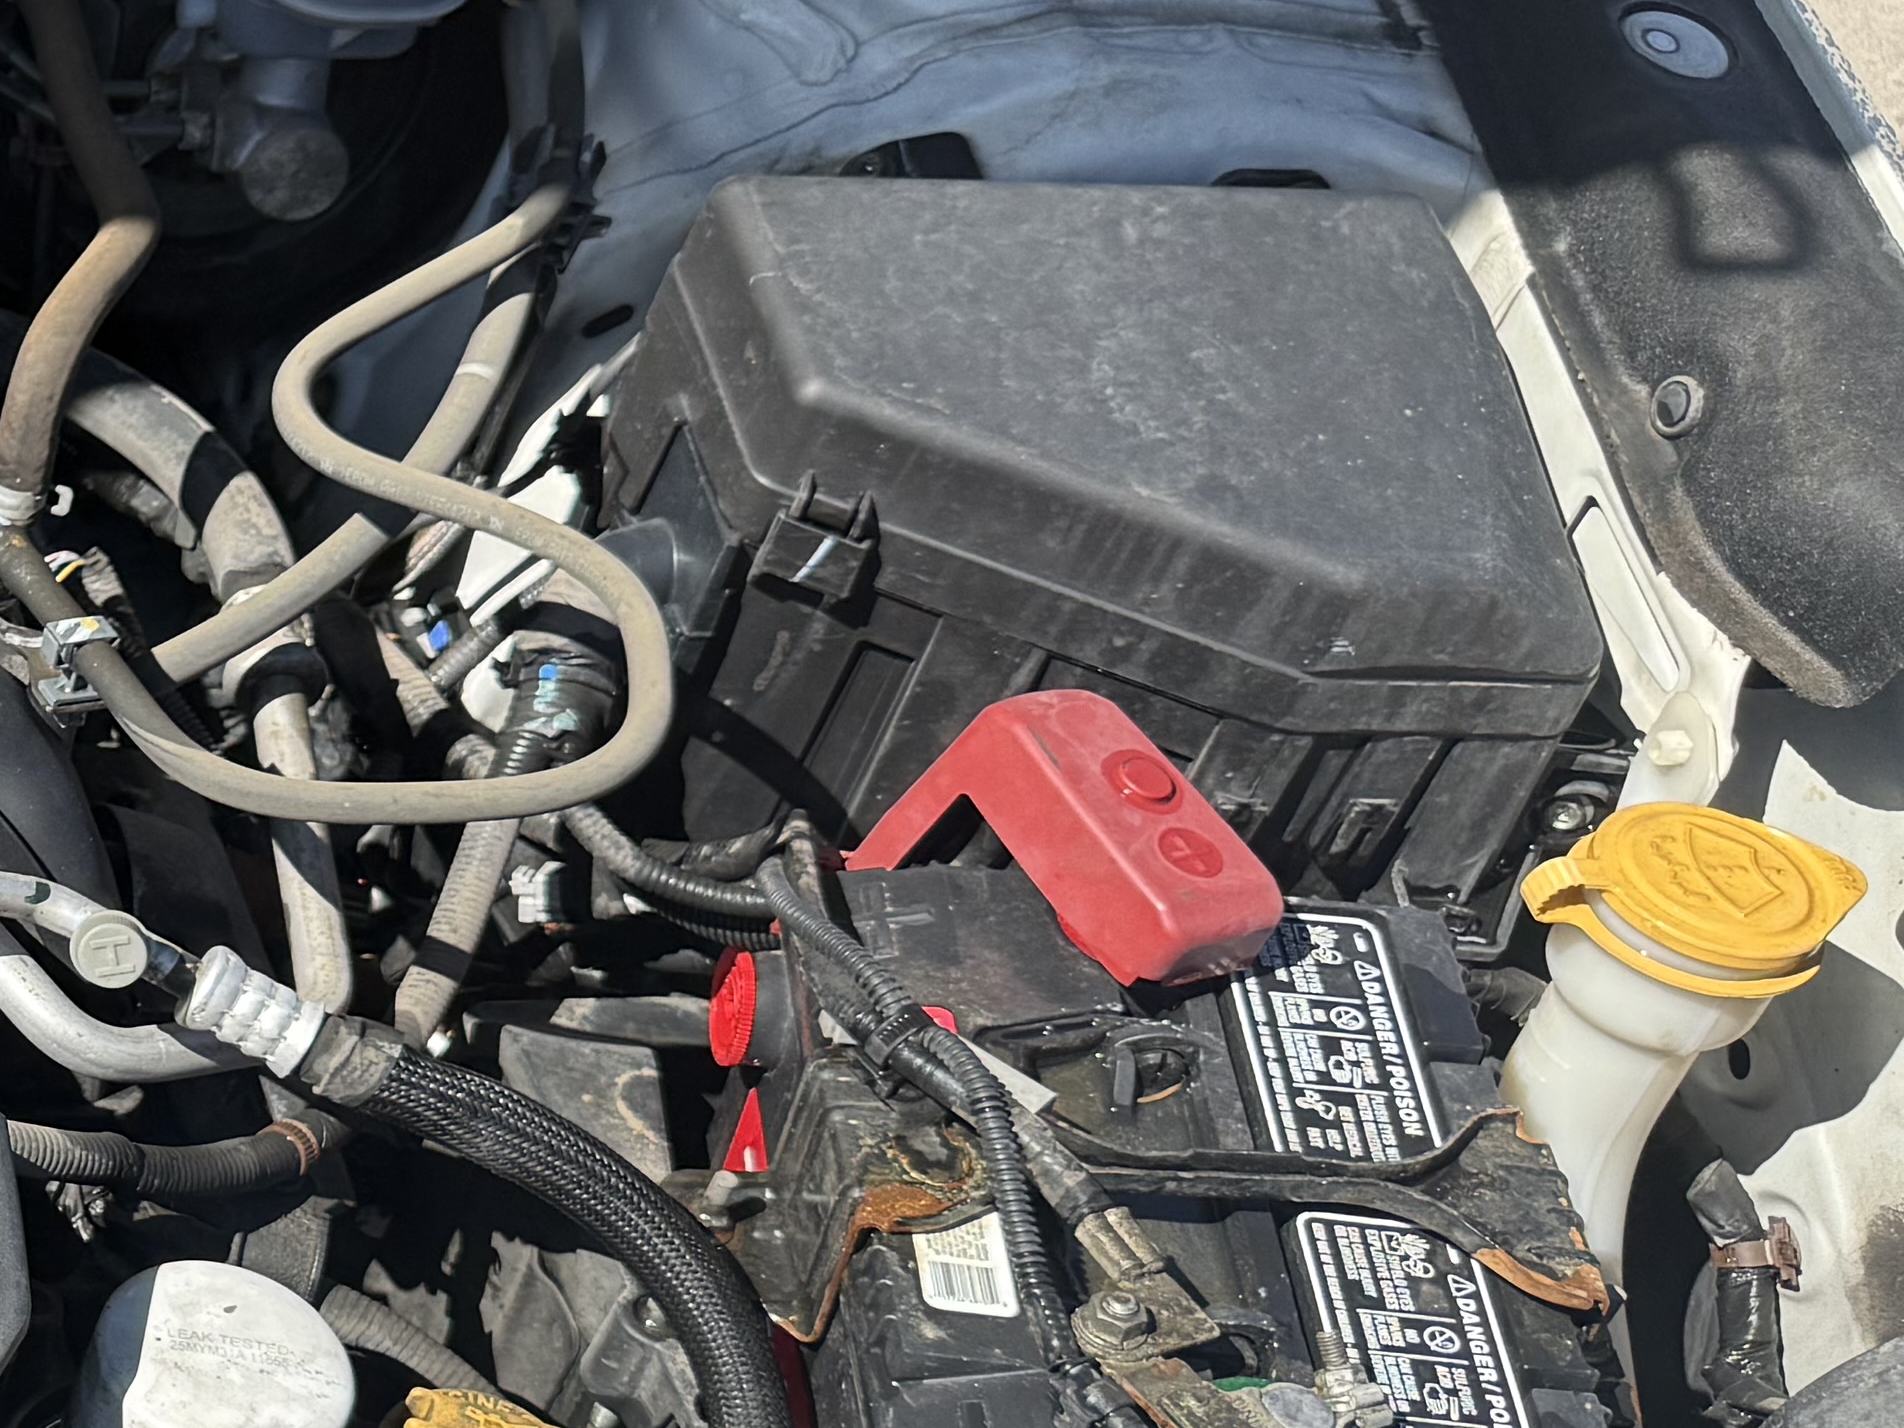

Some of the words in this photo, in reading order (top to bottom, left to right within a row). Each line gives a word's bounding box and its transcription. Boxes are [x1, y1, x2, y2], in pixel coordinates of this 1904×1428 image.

[1361, 980, 1425, 1138] DANGER/POISON
[167, 1328, 214, 1344] LEAK
[219, 1334, 290, 1356] TESTED
